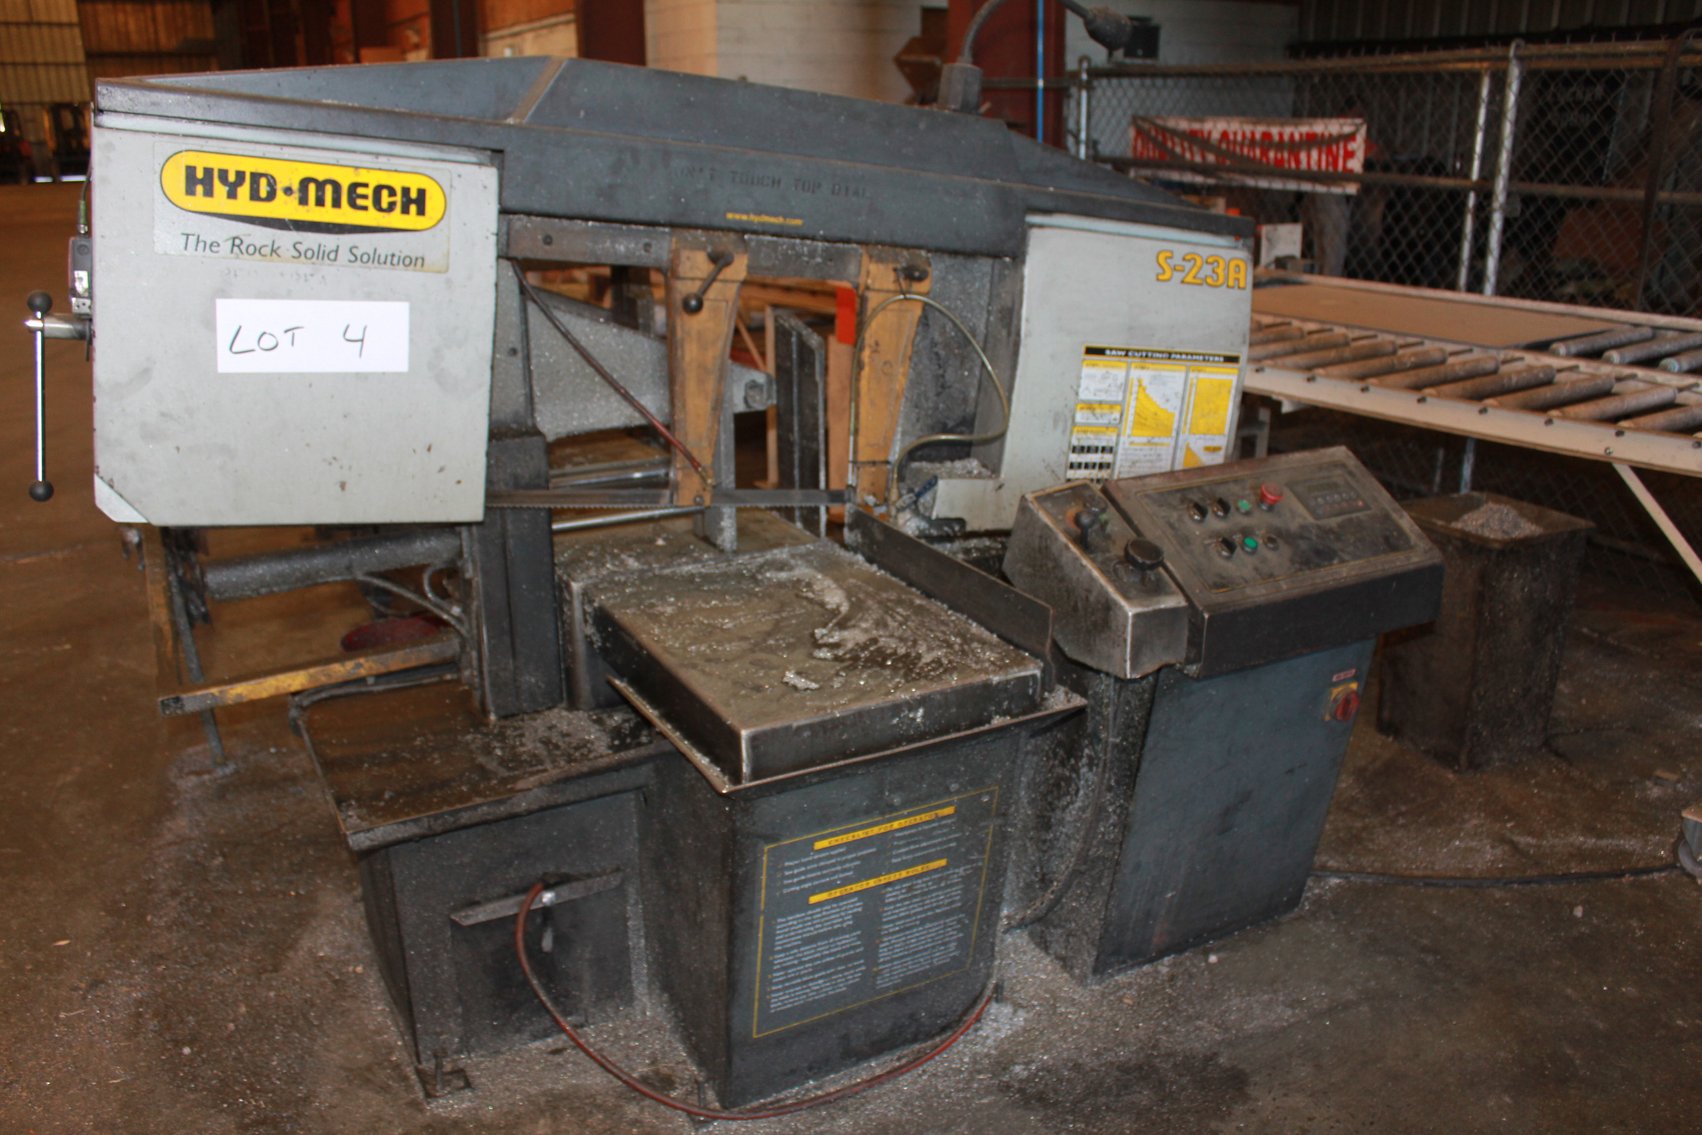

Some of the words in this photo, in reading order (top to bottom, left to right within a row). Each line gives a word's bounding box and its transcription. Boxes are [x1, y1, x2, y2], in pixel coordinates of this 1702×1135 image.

[793, 179, 823, 195] TOP
[181, 233, 221, 255] The
[229, 236, 281, 259] Rock
[290, 241, 340, 263] Solid
[347, 246, 425, 269] Solution
[1156, 251, 1248, 290] S-23A
[229, 325, 304, 356] LOT
[342, 324, 368, 359] 4
[1104, 349, 1126, 357] SAW
[1127, 351, 1170, 359] CUTTING
[1170, 352, 1225, 363] PARAMETERS
